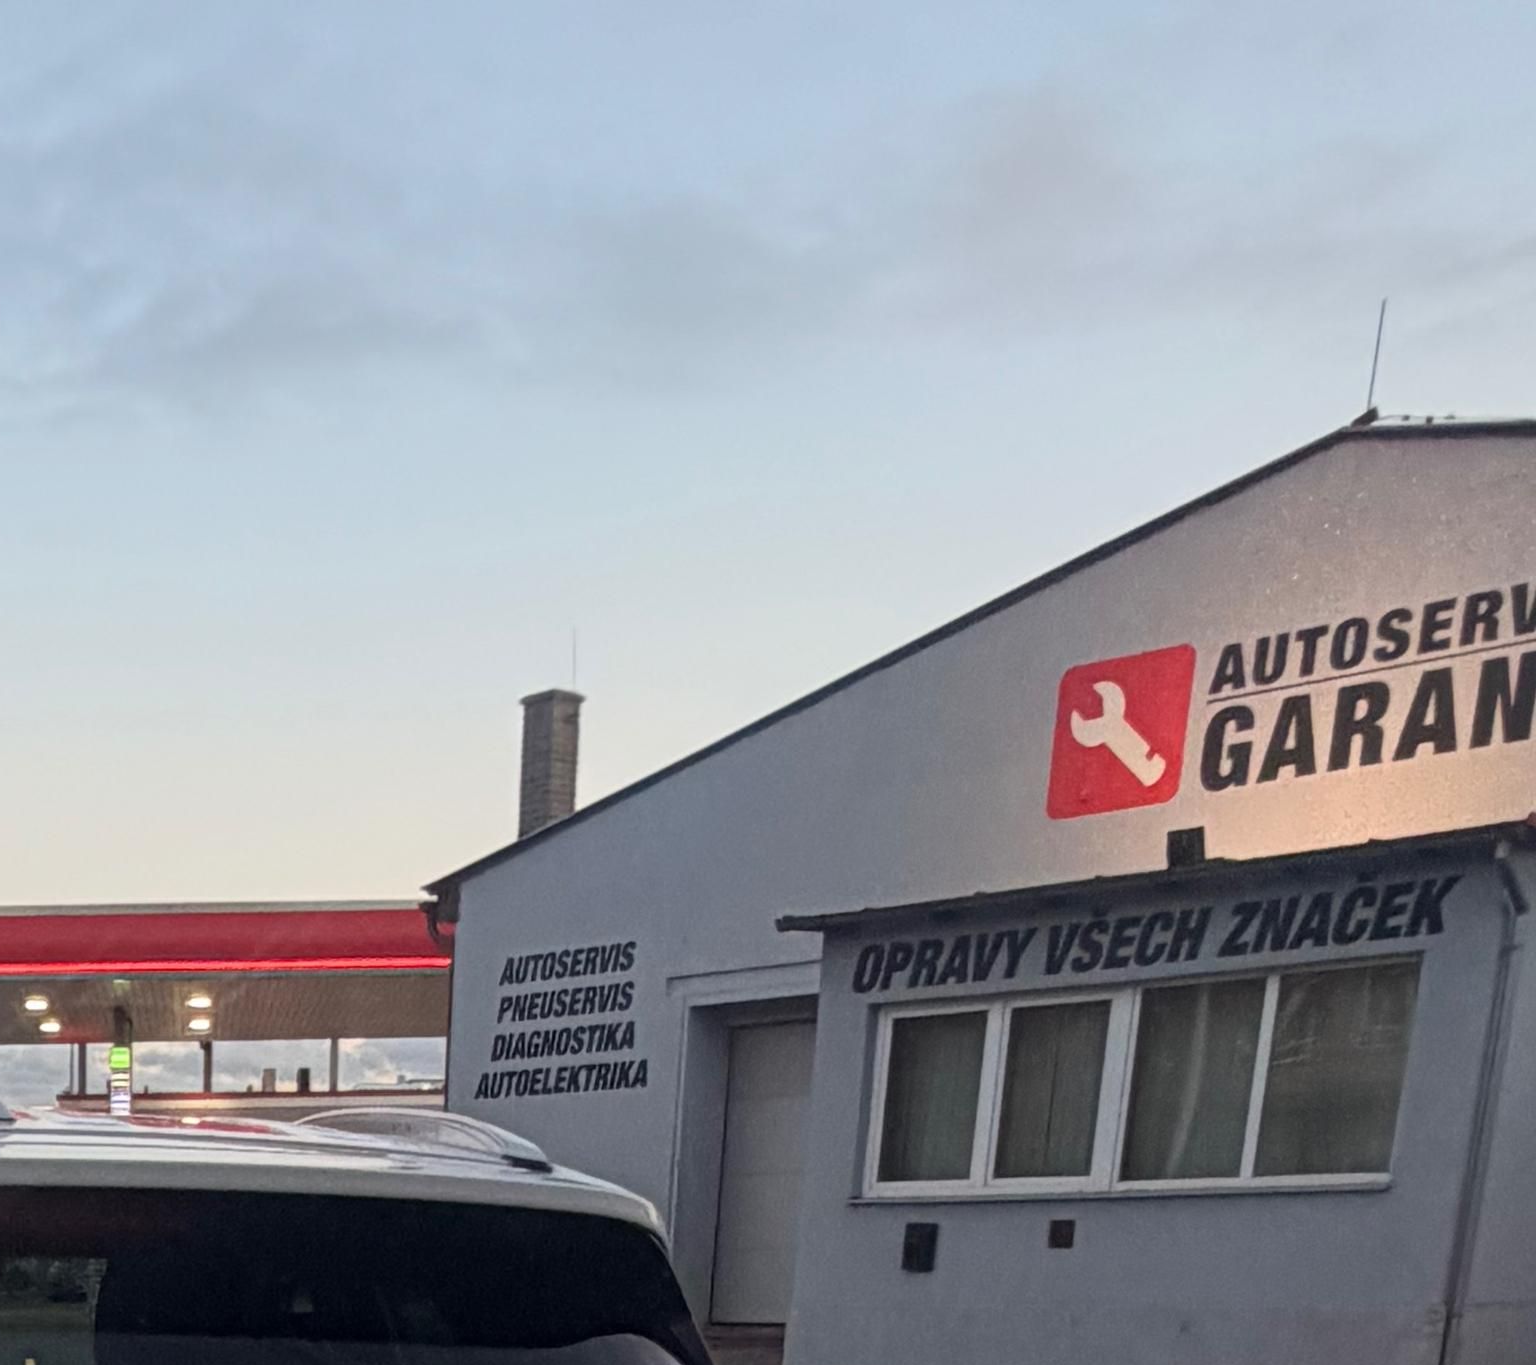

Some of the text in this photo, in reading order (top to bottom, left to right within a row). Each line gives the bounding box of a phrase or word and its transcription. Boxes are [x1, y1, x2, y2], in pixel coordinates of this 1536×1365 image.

[1200, 651, 1536, 792] GARAN
[852, 871, 1462, 994] OPRAVY VŠECH ZNAČEK
[499, 941, 637, 986] AUTOSERVIS
[497, 981, 635, 1024] PNEUSERVIS
[491, 1021, 635, 1062] DIAGNOSTIKA
[474, 1059, 648, 1099] AUTOELEKTRIKA
